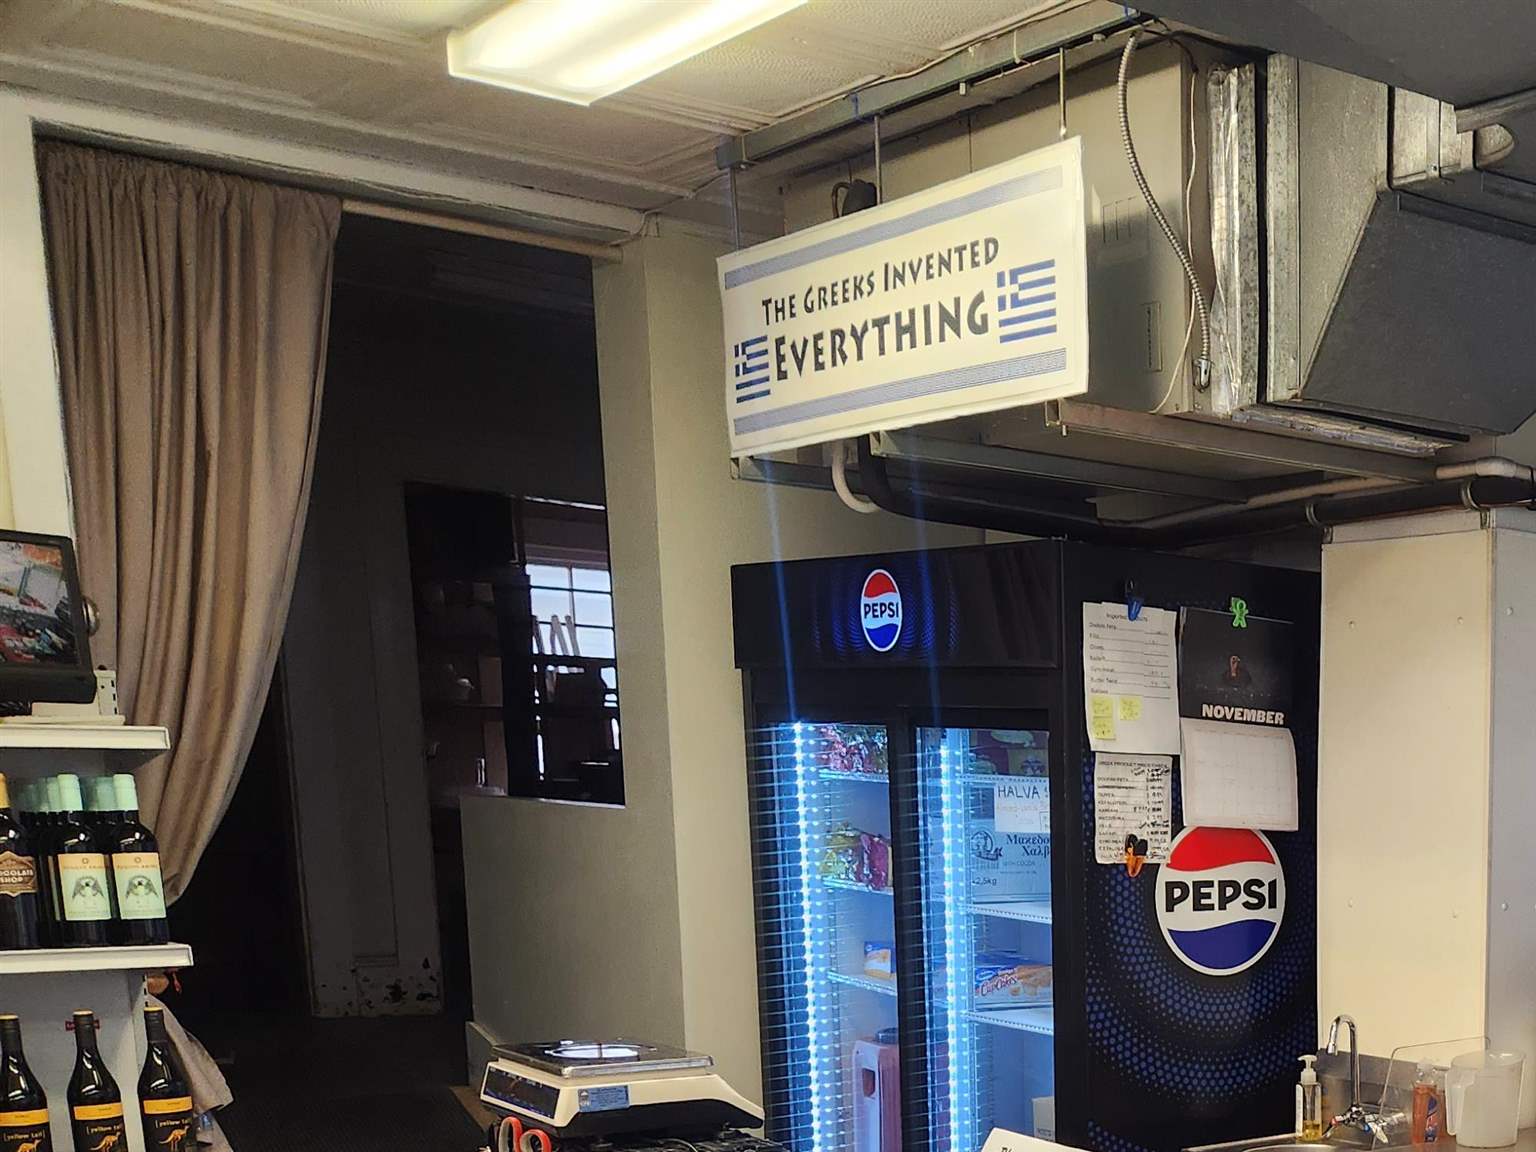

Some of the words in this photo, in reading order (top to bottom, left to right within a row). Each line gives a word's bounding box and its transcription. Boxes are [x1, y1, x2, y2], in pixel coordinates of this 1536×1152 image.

[762, 293, 796, 326] THE
[804, 269, 875, 314] GREEKS
[883, 236, 1000, 292] INVENTED
[774, 289, 989, 381] EVERYTHING
[863, 602, 900, 619] PEPSI
[1202, 703, 1285, 725] NOVEMBER
[997, 785, 1041, 799] HALVA
[1165, 878, 1277, 912] PEPSI
